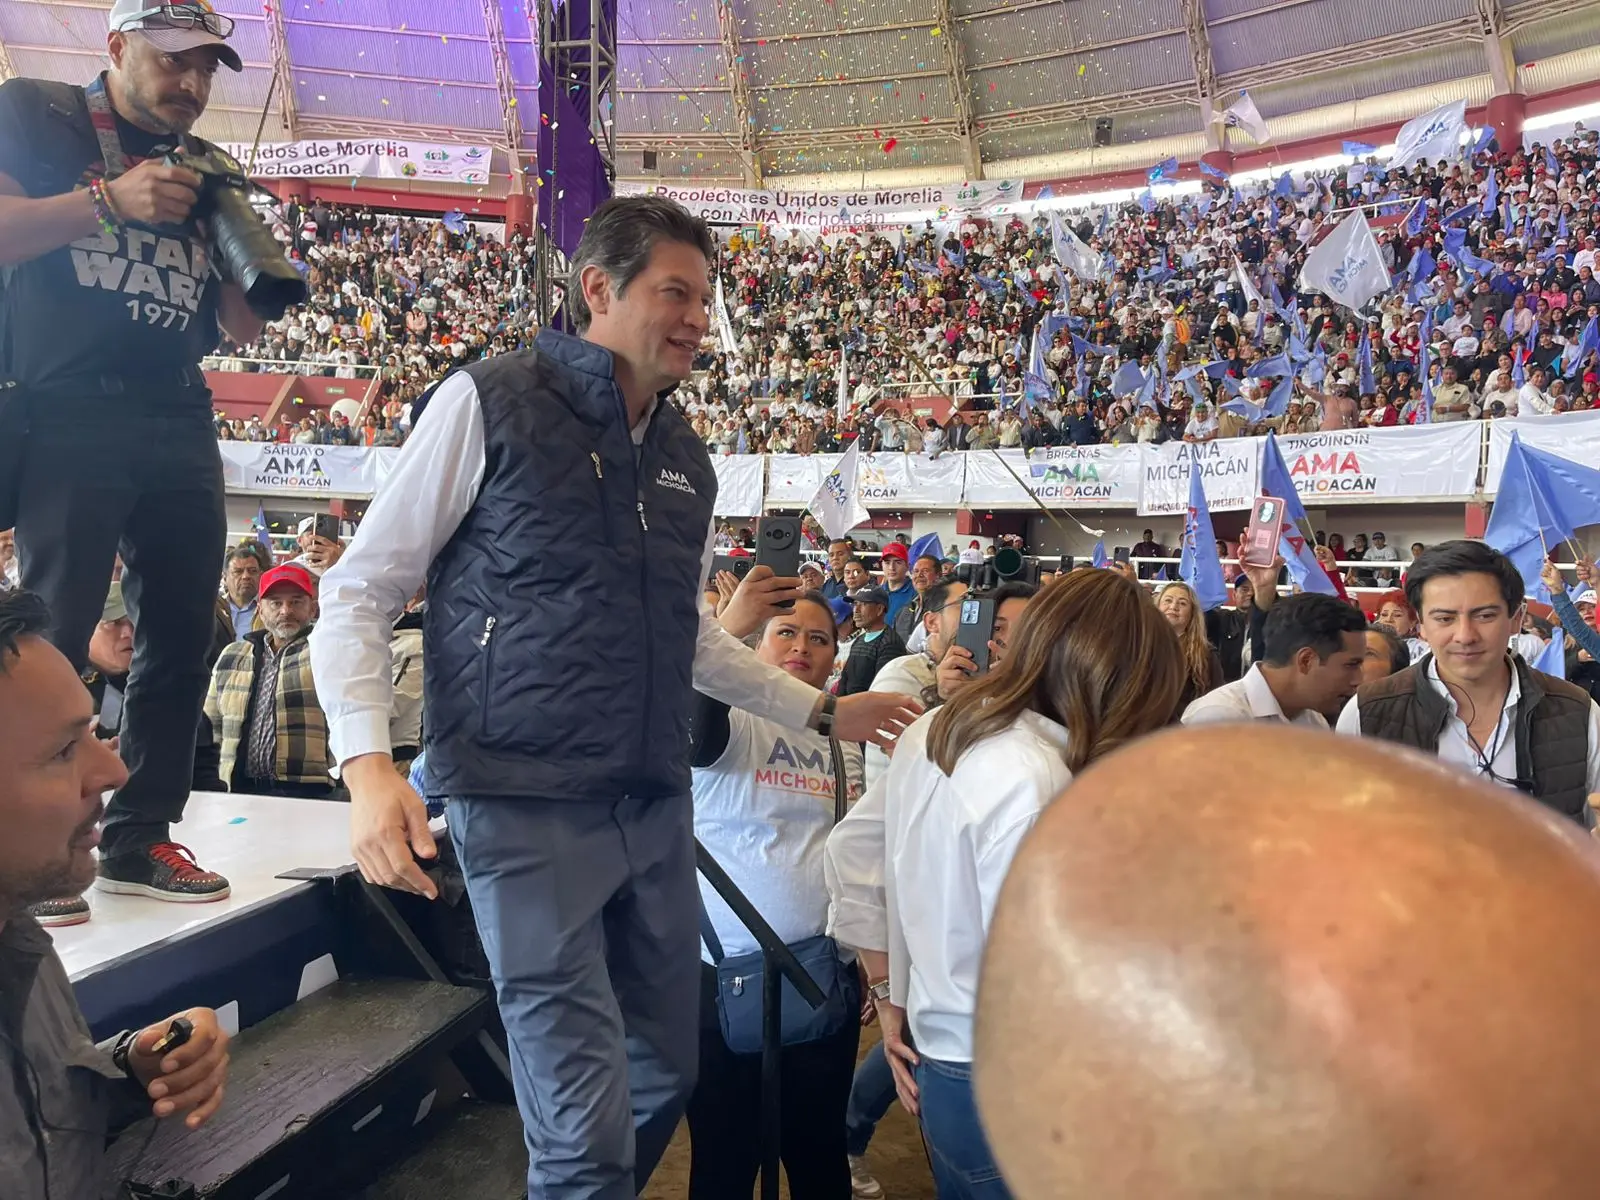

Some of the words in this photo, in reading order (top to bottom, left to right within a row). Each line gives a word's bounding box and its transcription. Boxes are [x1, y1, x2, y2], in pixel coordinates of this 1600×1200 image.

[228, 143, 299, 160] Unidos
[305, 142, 330, 158] de
[336, 141, 409, 158] Morelia
[656, 186, 769, 206] Recolectores
[776, 190, 840, 208] Unidos
[846, 192, 869, 207] de
[874, 187, 943, 206] Morelia
[700, 208, 733, 222] con
[738, 207, 781, 224] AMA
[125, 299, 190, 332] 1977
[263, 446, 325, 457] SAHUAYO
[1176, 442, 1221, 461] AMA
[263, 457, 325, 476] AMA
[1043, 463, 1101, 483] AMA
[1290, 450, 1361, 477] AMA
[660, 468, 691, 487] AMA
